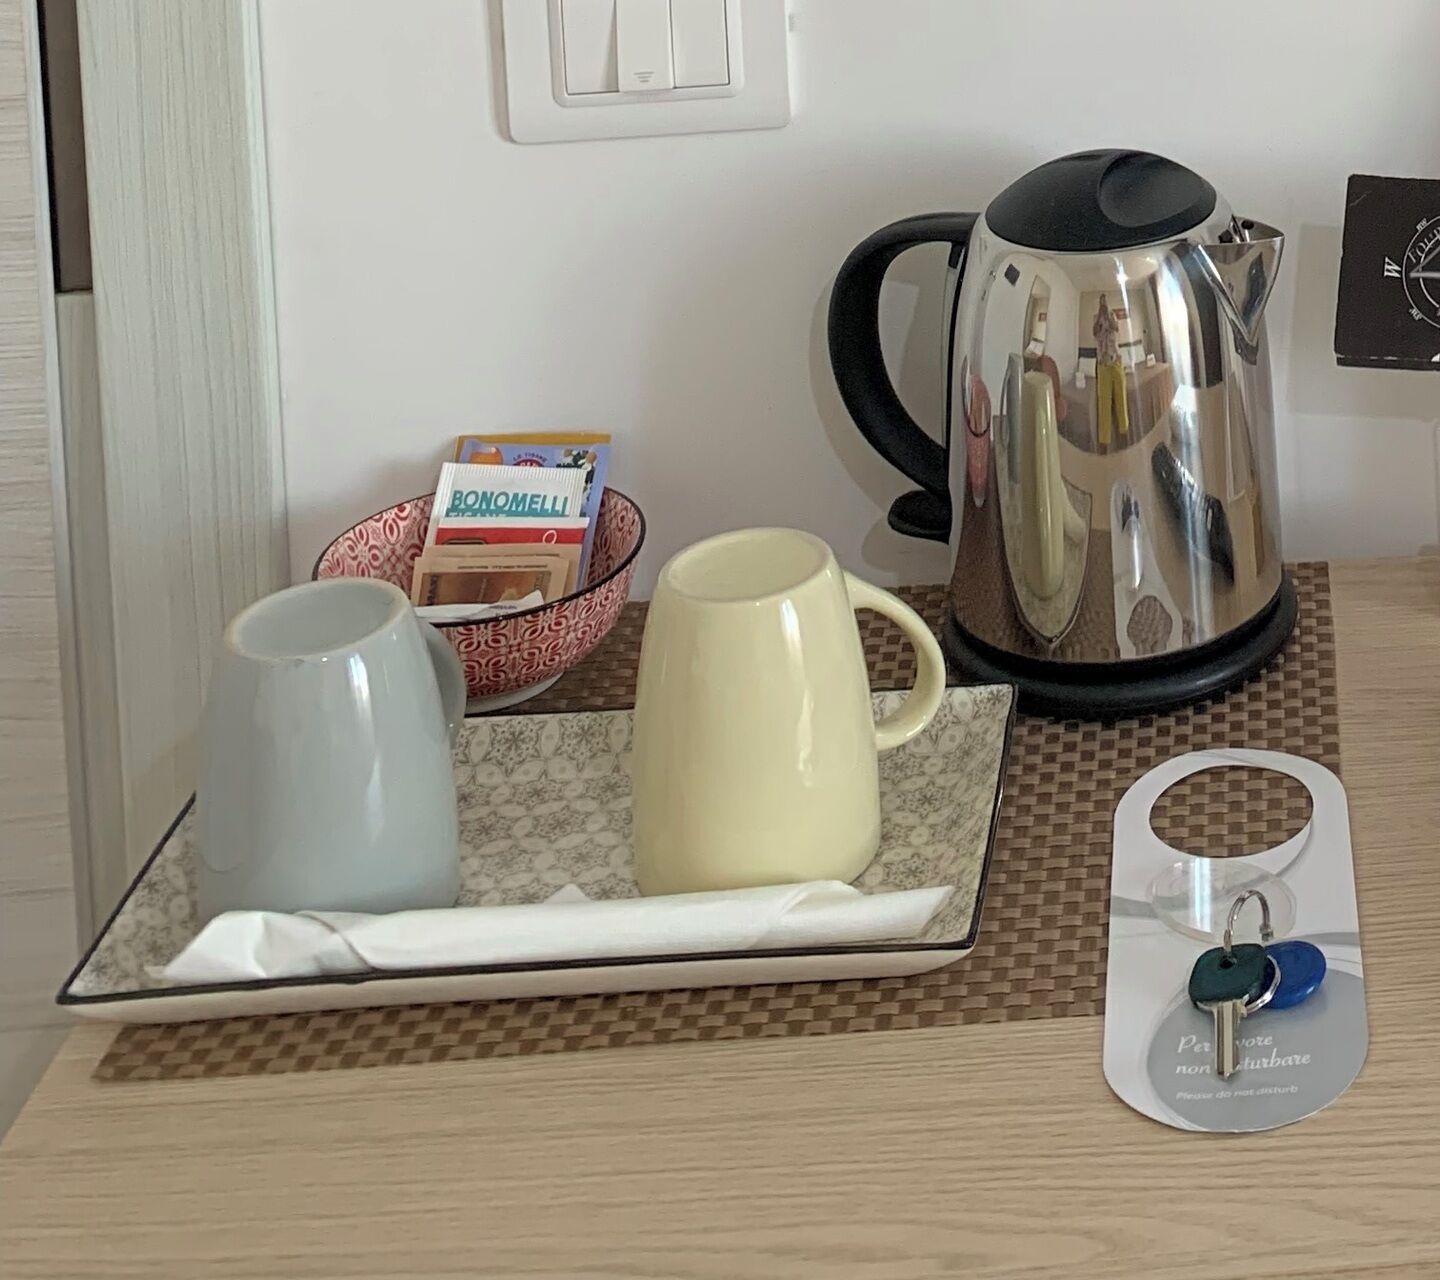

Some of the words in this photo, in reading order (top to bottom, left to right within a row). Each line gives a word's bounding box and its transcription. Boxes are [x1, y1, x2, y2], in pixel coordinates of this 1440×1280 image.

[1384, 256, 1403, 279] W
[452, 490, 569, 514] BONOMELLI
[1178, 1034, 1211, 1054] Per
[1176, 1064, 1211, 1075] non
[1216, 1088, 1232, 1099] do
[1234, 1087, 1255, 1097] not
